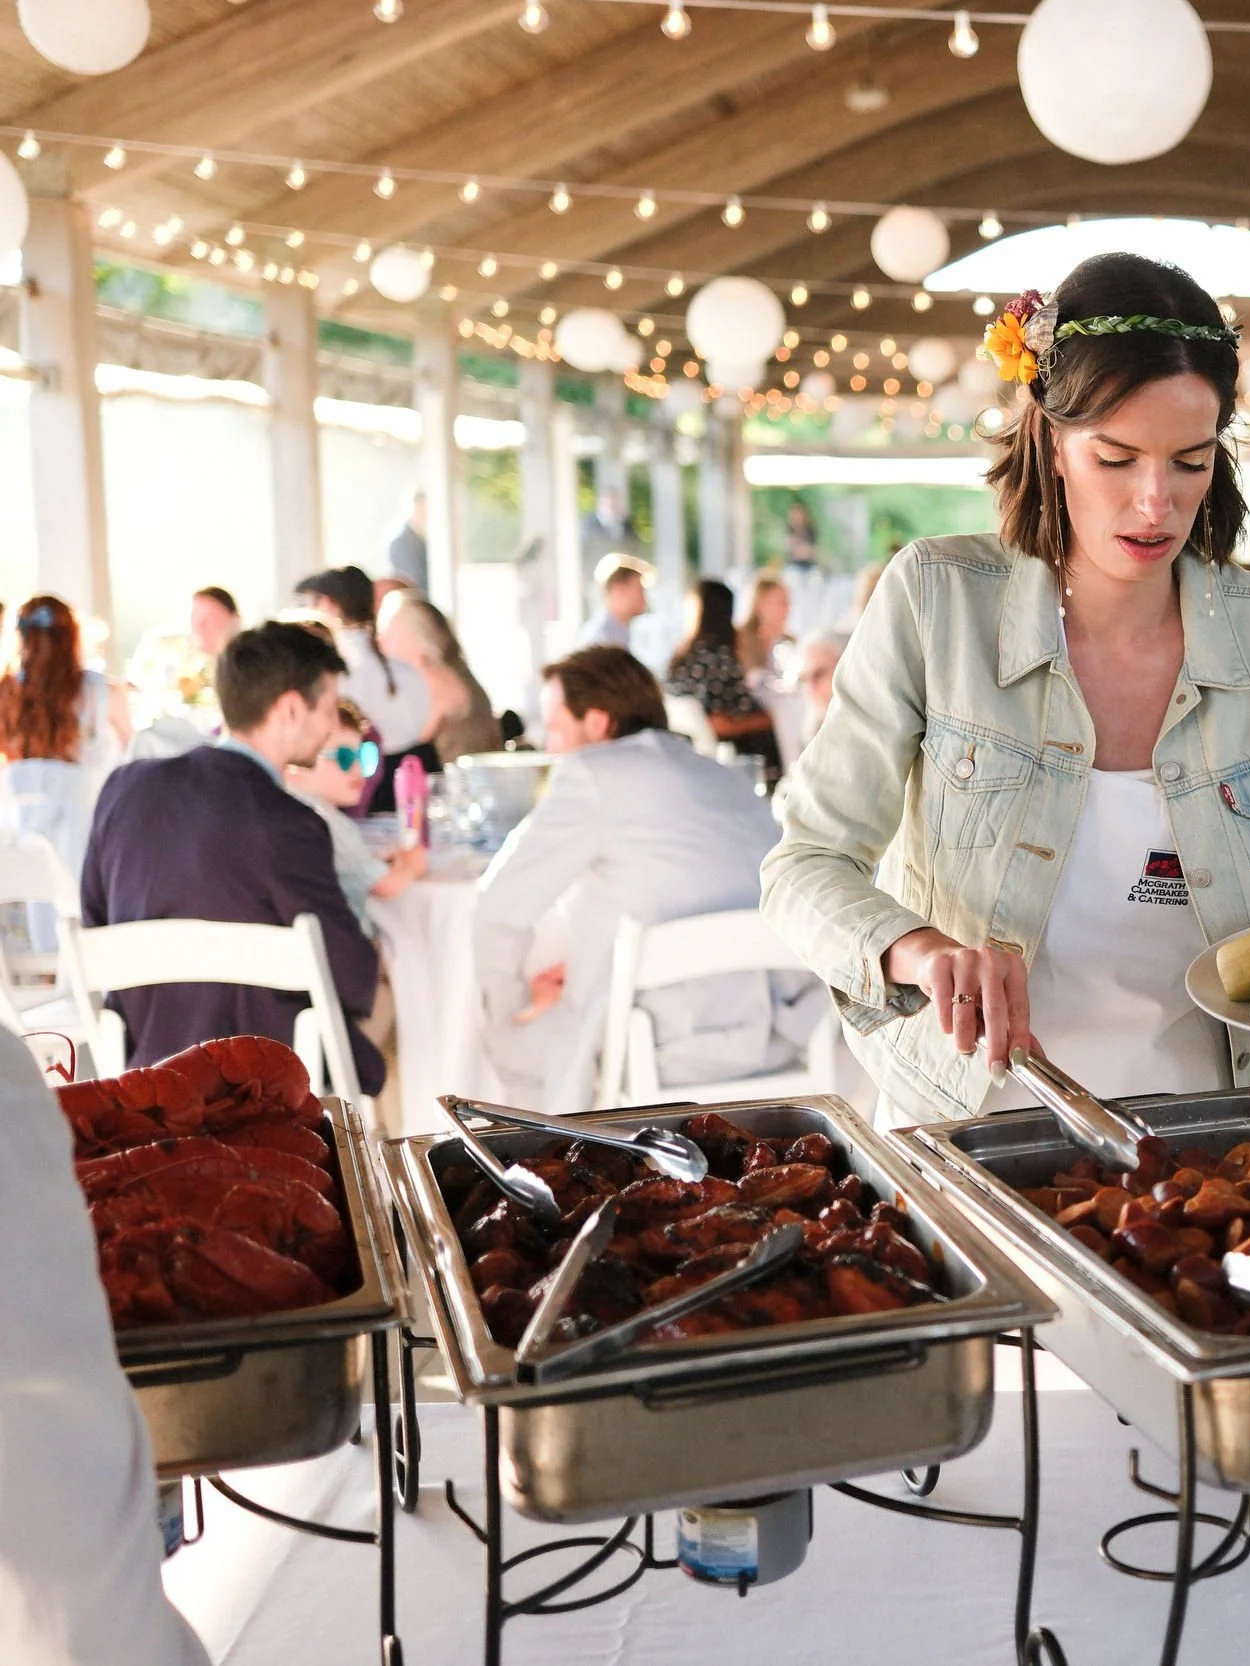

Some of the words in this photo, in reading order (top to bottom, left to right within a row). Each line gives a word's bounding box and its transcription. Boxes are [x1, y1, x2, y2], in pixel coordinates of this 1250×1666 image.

[1131, 885, 1189, 897] CLAMBAKES
[1127, 893, 1136, 901] &
[1138, 895, 1188, 905] CATERING
